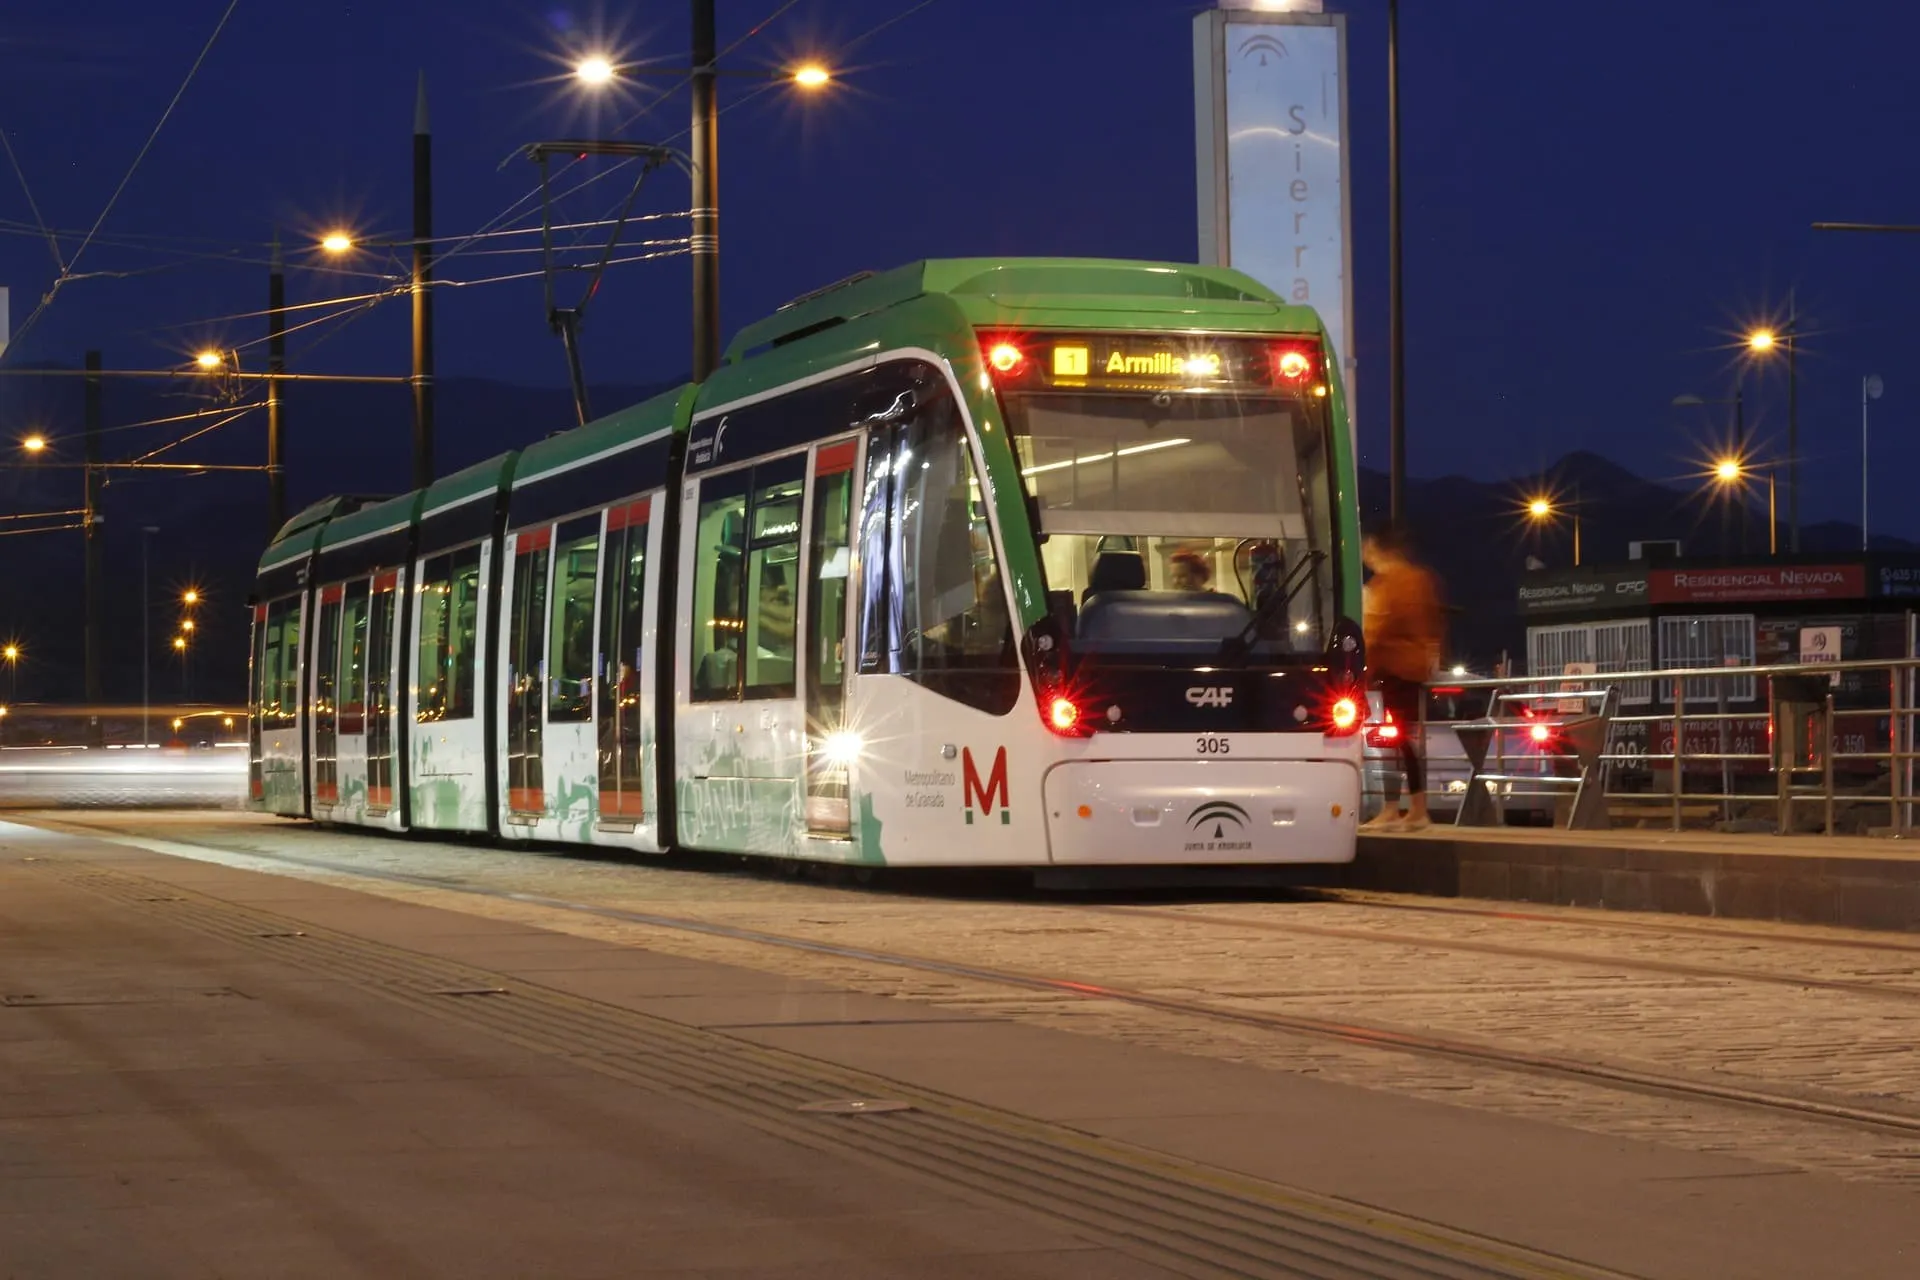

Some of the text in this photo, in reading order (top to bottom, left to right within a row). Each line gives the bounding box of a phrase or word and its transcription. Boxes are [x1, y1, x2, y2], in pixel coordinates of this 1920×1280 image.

[1288, 105, 1309, 301] Sierra
[1106, 351, 1184, 374] Armilla
[1780, 570, 1845, 585] NEVADA
[1185, 686, 1234, 708] CAF
[1196, 737, 1230, 754] 305
[904, 769, 956, 788] Metropolitano
[962, 745, 1010, 825] M
[904, 791, 945, 808] de Granada
[1207, 842, 1215, 850] DE
